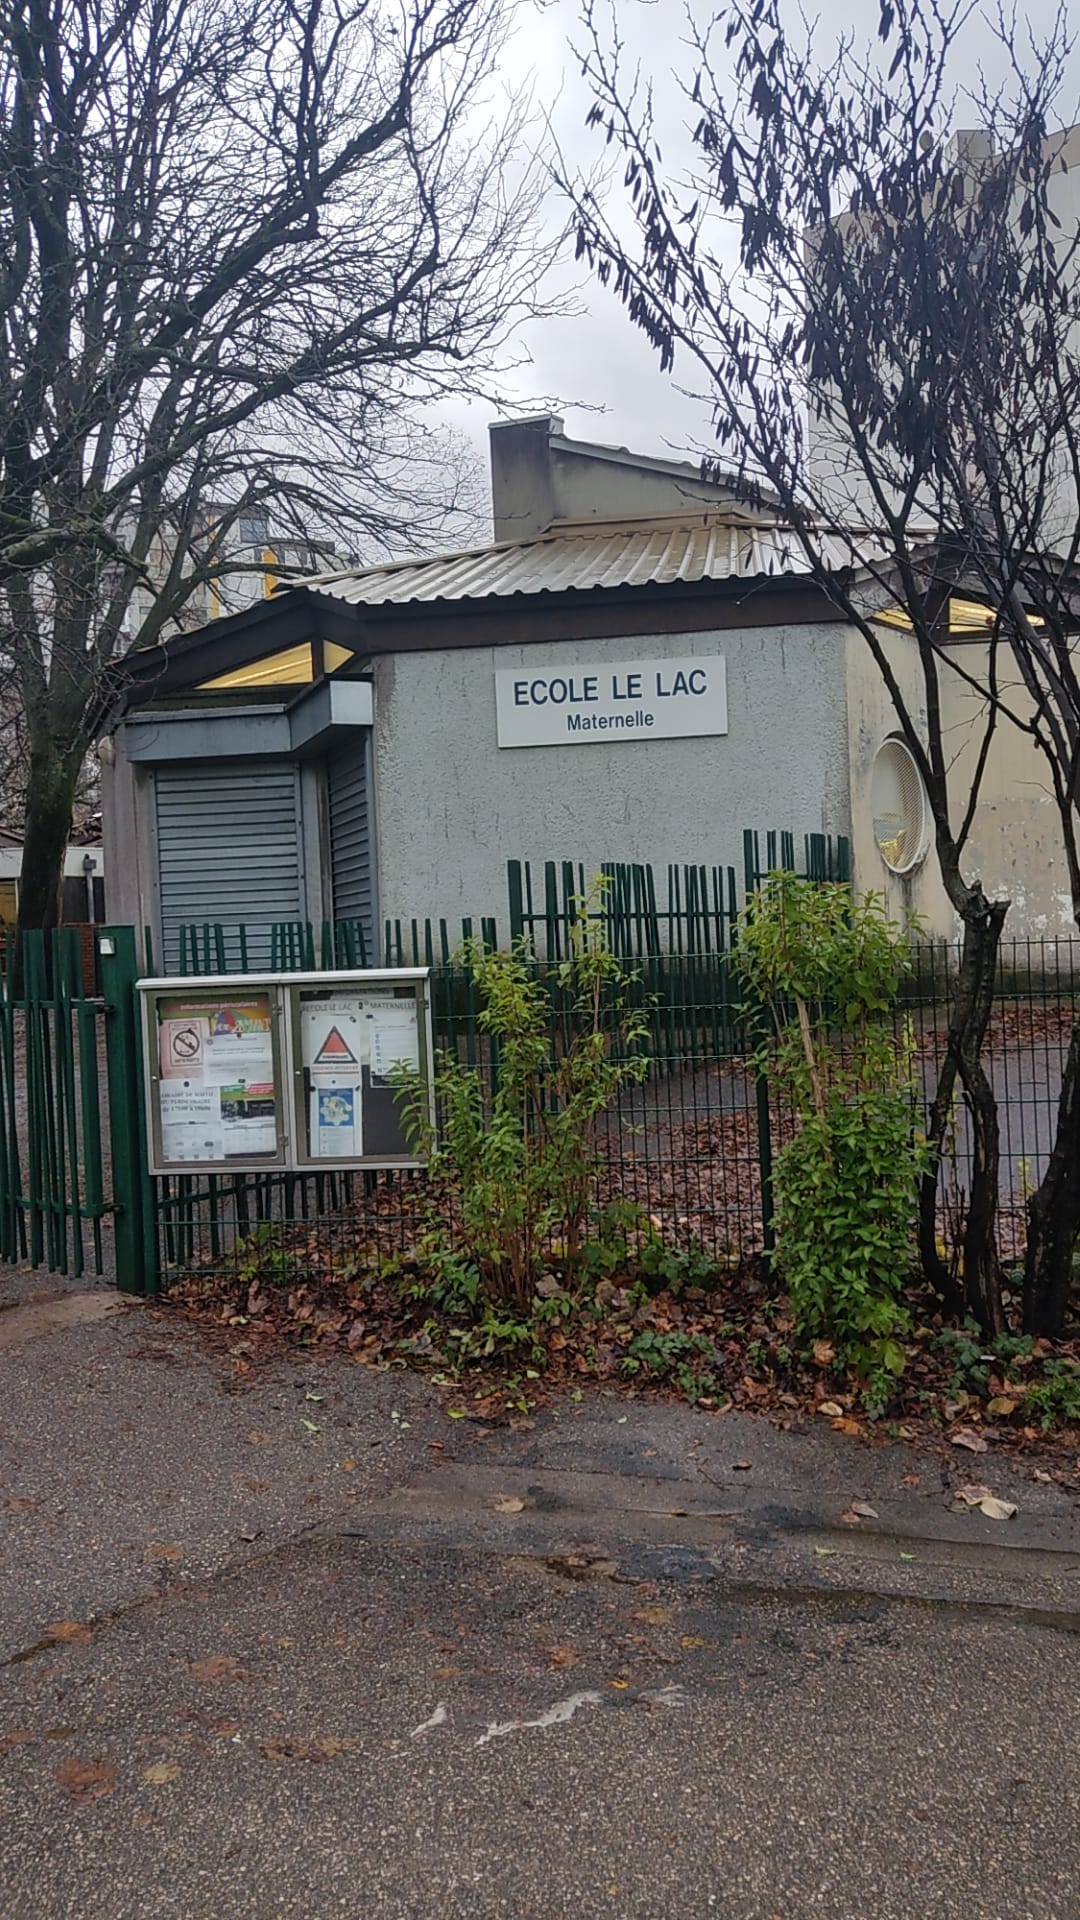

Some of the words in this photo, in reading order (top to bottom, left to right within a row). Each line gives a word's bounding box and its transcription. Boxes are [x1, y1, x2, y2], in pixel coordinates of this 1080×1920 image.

[513, 677, 599, 706] ECOLE
[612, 674, 643, 700] LE
[656, 669, 707, 697] LAC
[567, 710, 655, 731] Maternelle
